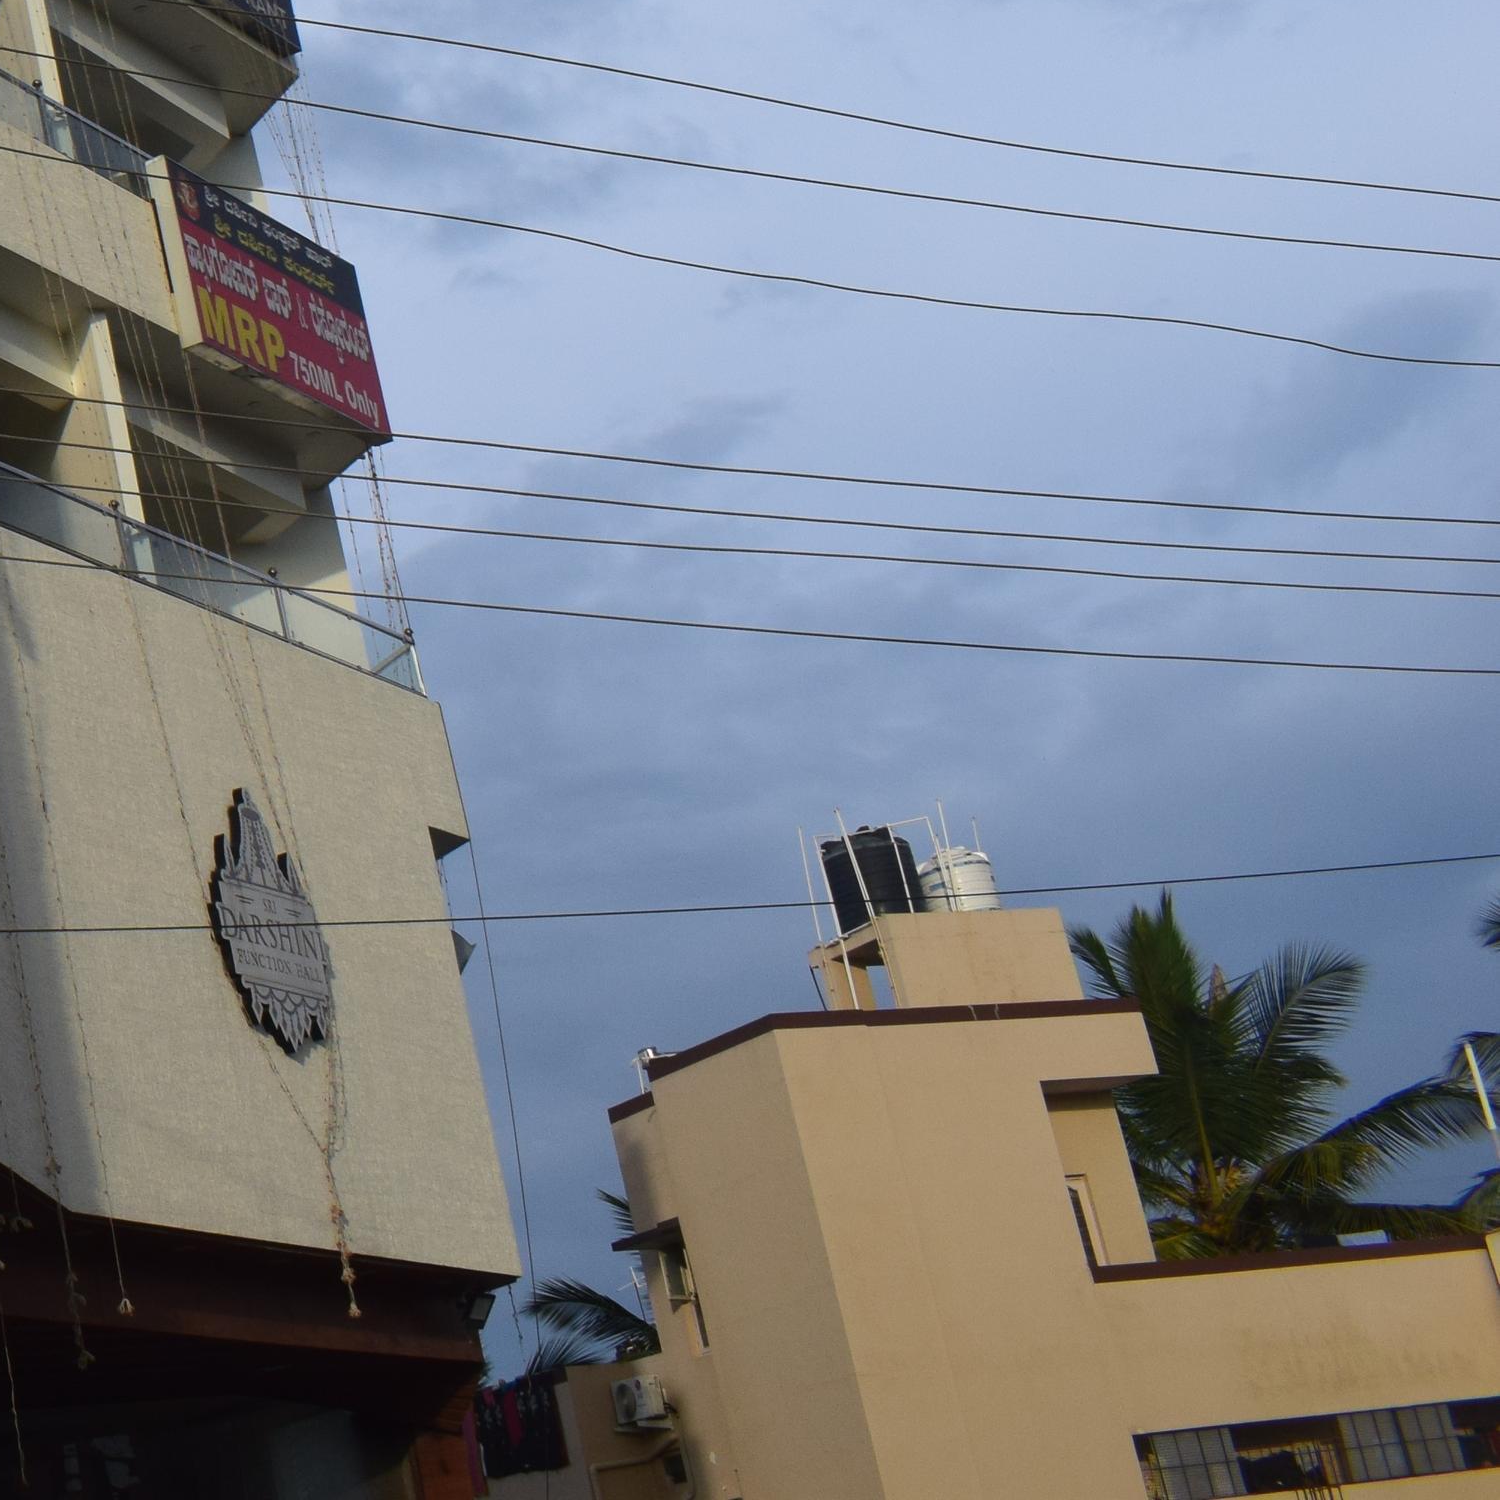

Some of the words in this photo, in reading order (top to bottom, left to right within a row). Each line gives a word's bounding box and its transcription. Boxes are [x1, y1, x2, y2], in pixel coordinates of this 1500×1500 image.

[204, 185, 220, 209] ಶ್ರೀ
[223, 199, 258, 229] ದರ್ಶಿನಿ
[213, 212, 232, 240] ಶ್ರೀ
[236, 229, 278, 263] ದರ್ಶಿನಿ
[196, 285, 286, 374] MRP
[289, 350, 344, 404] 750ML
[344, 379, 379, 428] Only
[219, 908, 328, 965] DARSHINI
[235, 947, 292, 974] FUNCTION
[296, 960, 324, 984] HALL
